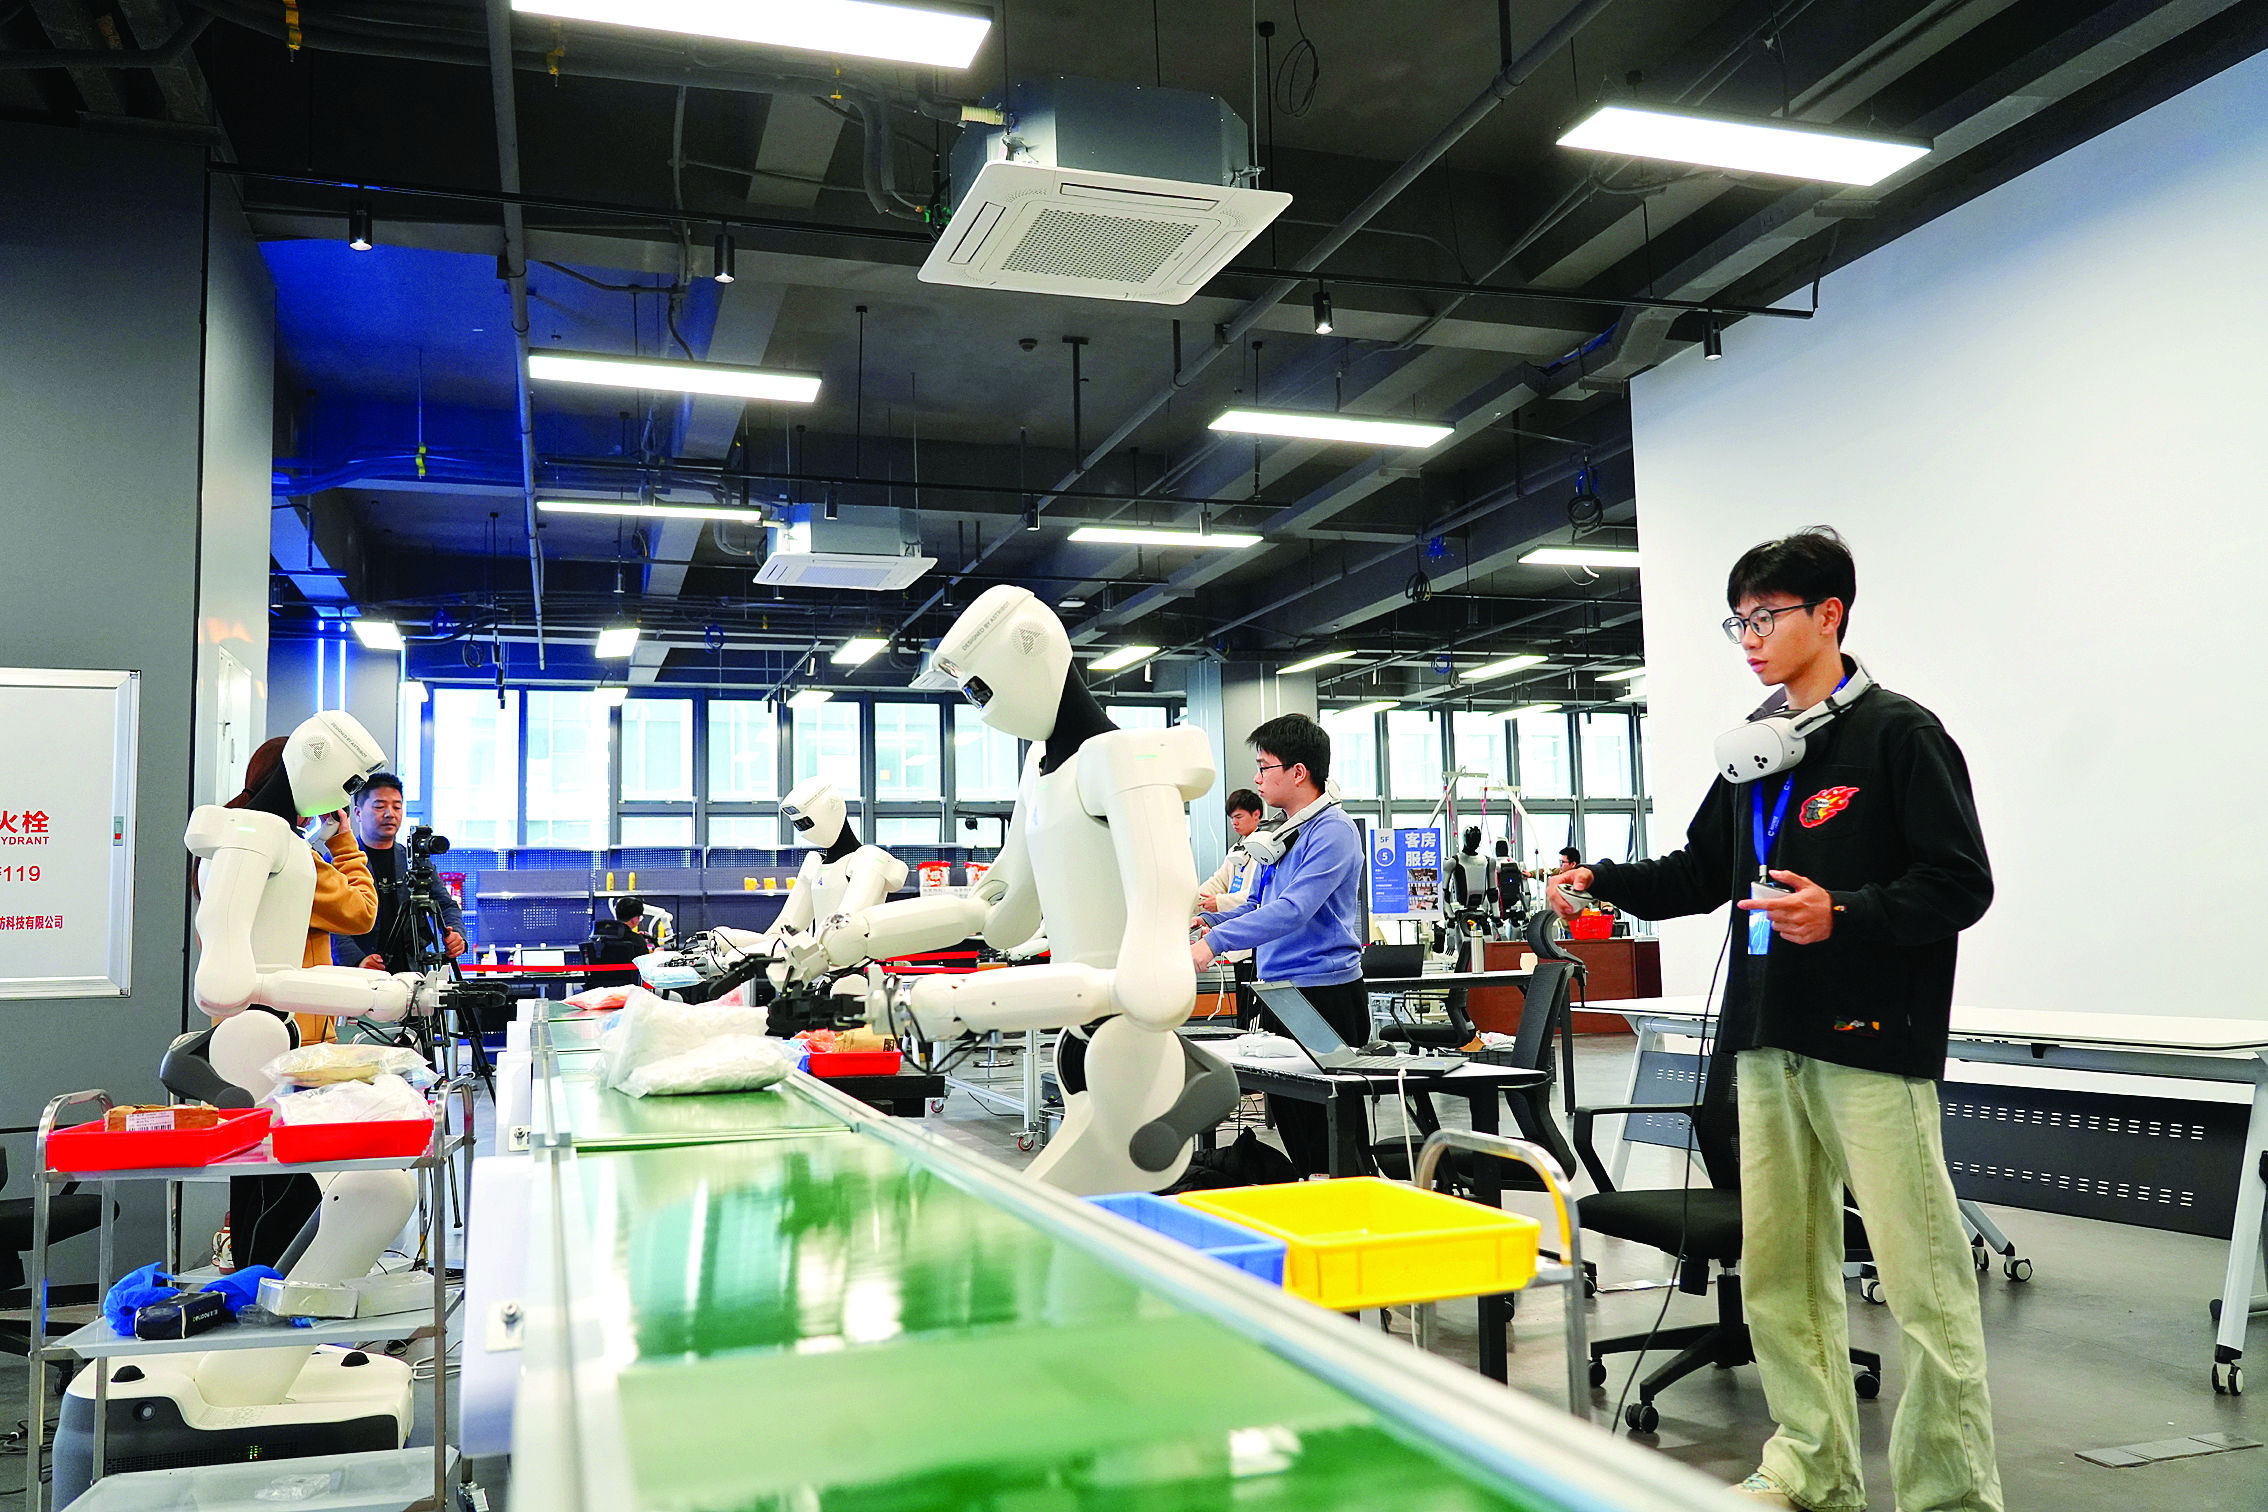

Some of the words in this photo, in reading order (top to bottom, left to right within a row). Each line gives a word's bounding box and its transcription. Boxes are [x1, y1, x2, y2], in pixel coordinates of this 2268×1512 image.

[962, 628, 985, 650] DESIGNED
[990, 601, 1010, 622] ASTRIBOT
[1, 836, 49, 845] YDRANT
[1405, 832, 1435, 848] 客房
[1382, 852, 1388, 861] 5
[1405, 851, 1436, 866] 服务
[0, 865, 41, 881] 119
